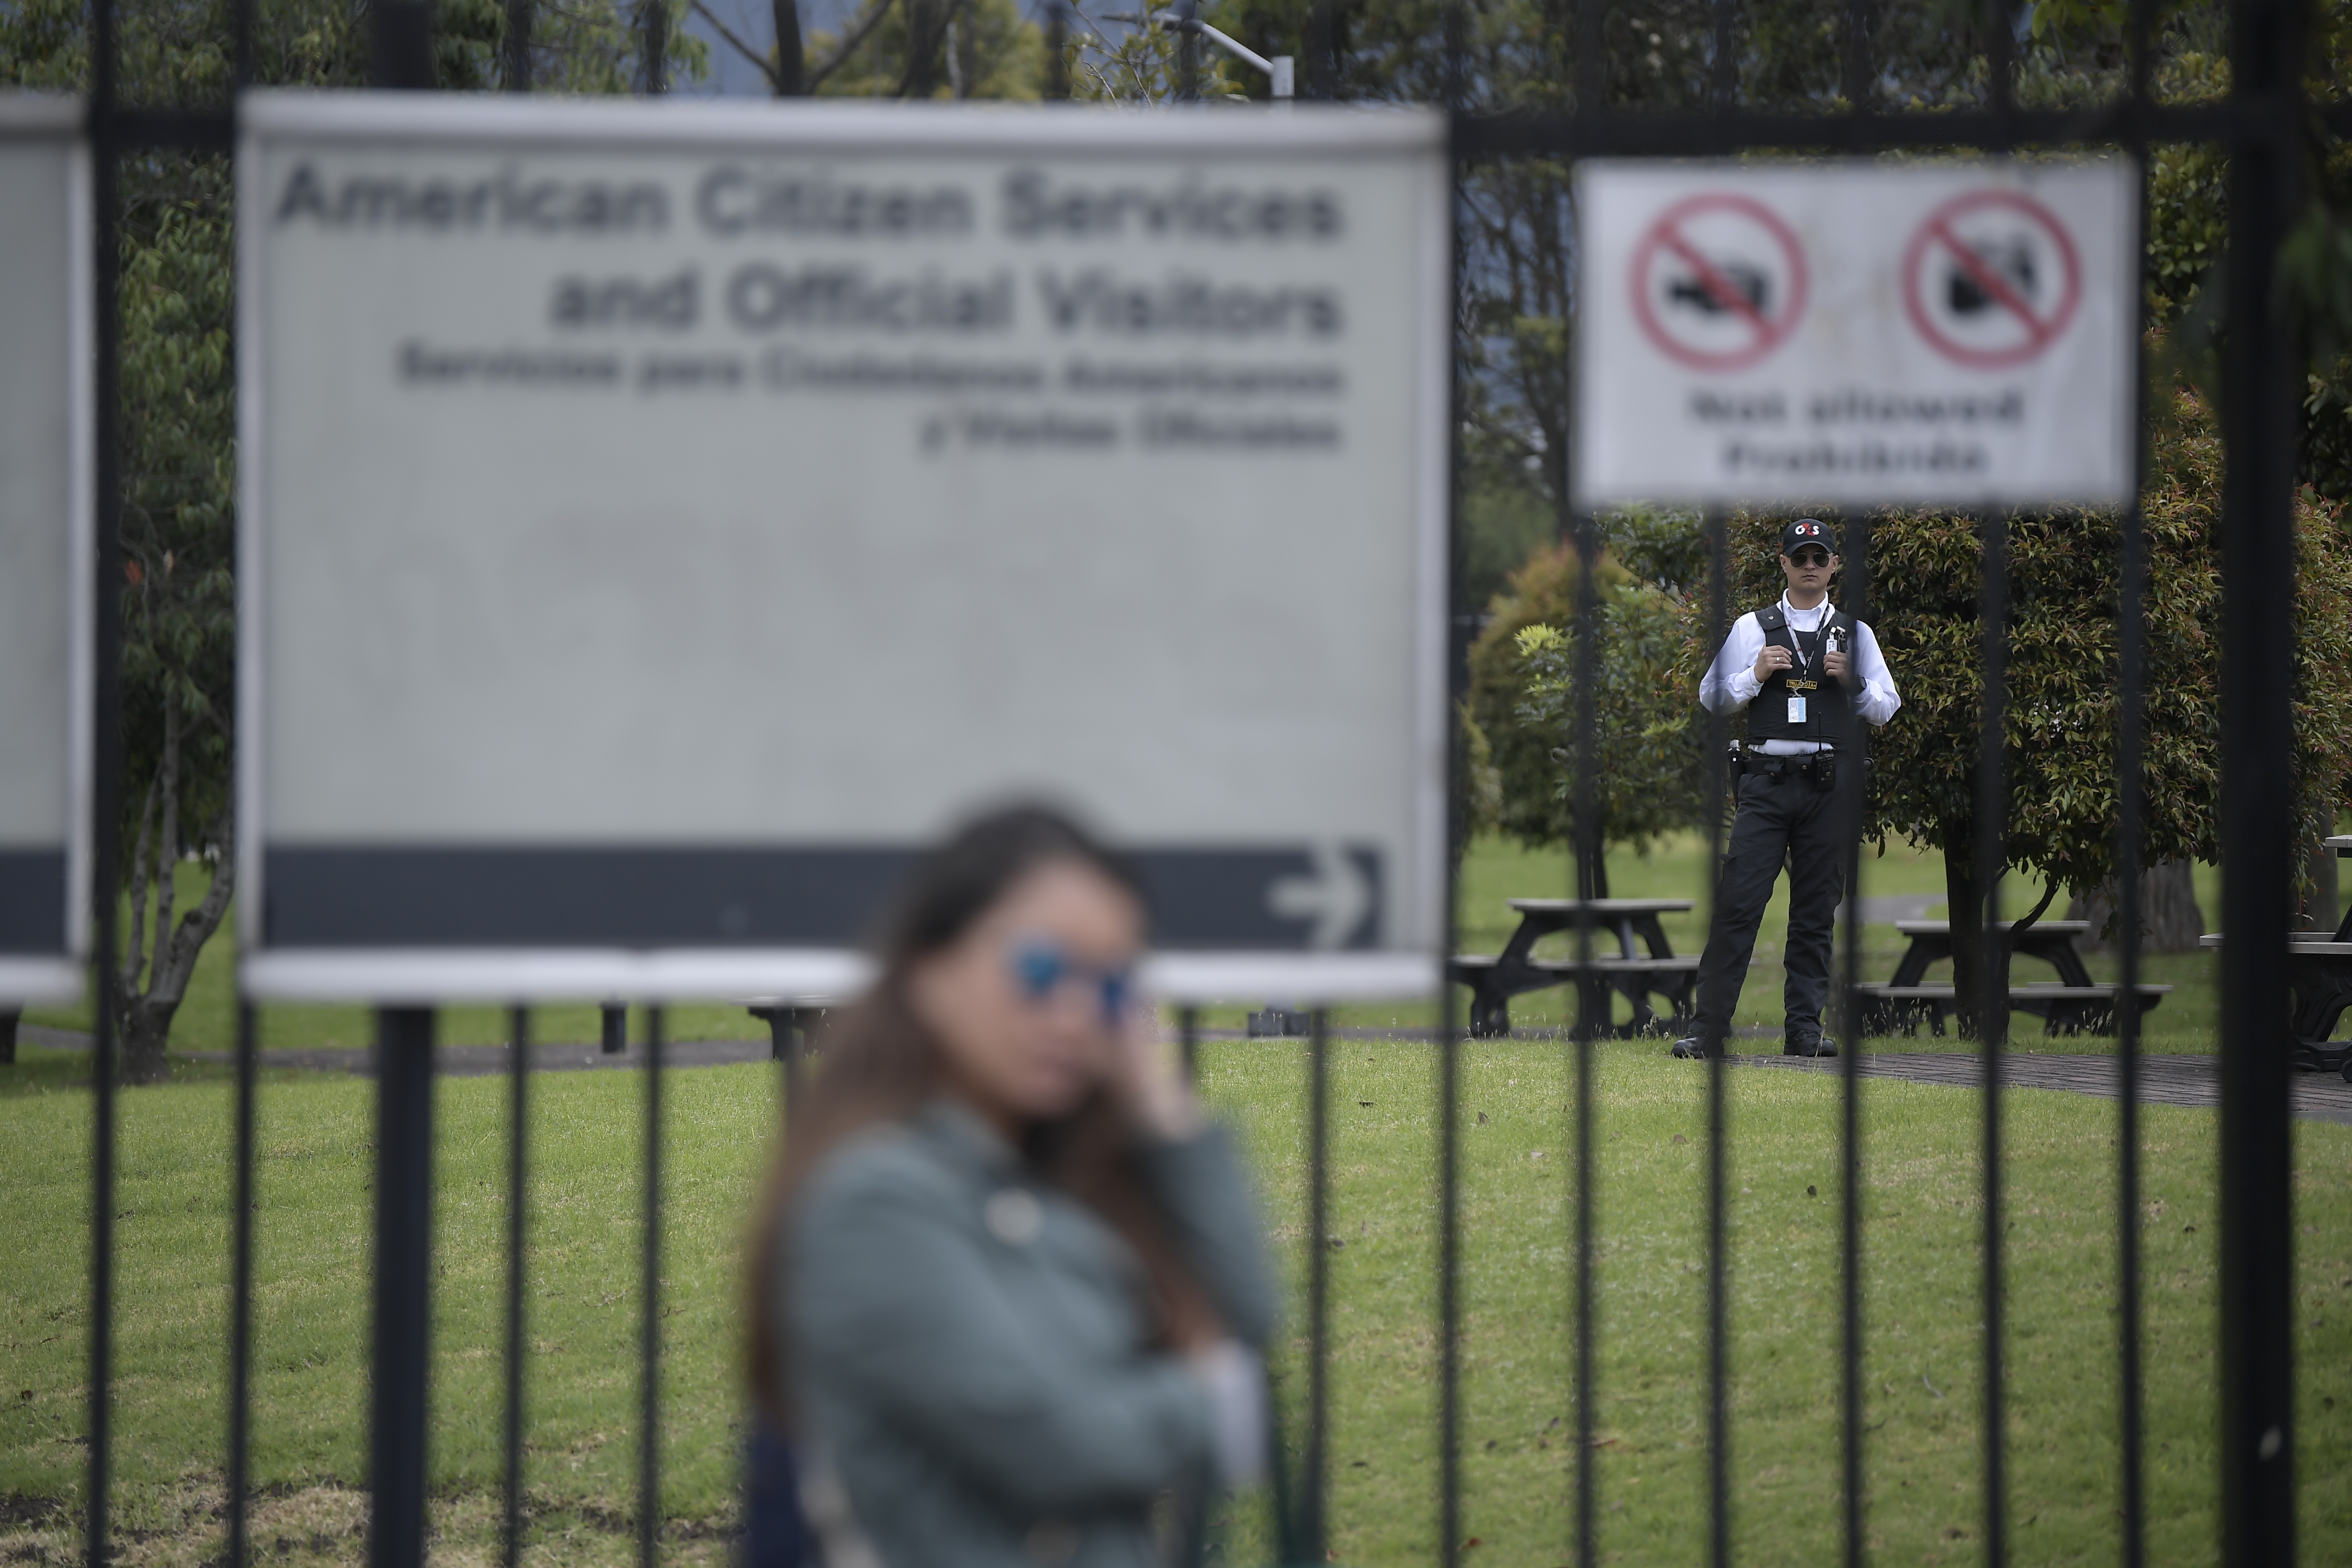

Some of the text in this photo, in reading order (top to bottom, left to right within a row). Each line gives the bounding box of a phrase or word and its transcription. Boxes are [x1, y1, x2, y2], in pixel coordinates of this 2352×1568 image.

[274, 164, 1345, 243] American Citizen Services
[547, 262, 1345, 339] and Official Visitors
[397, 342, 1347, 400] Servicios para Ciudadanos Americanos
[1688, 386, 2024, 426] Not allowed
[916, 410, 1344, 455] y Visitas Oficiales
[1721, 438, 1988, 475] Prohibido
[1795, 523, 1820, 536] G4S
